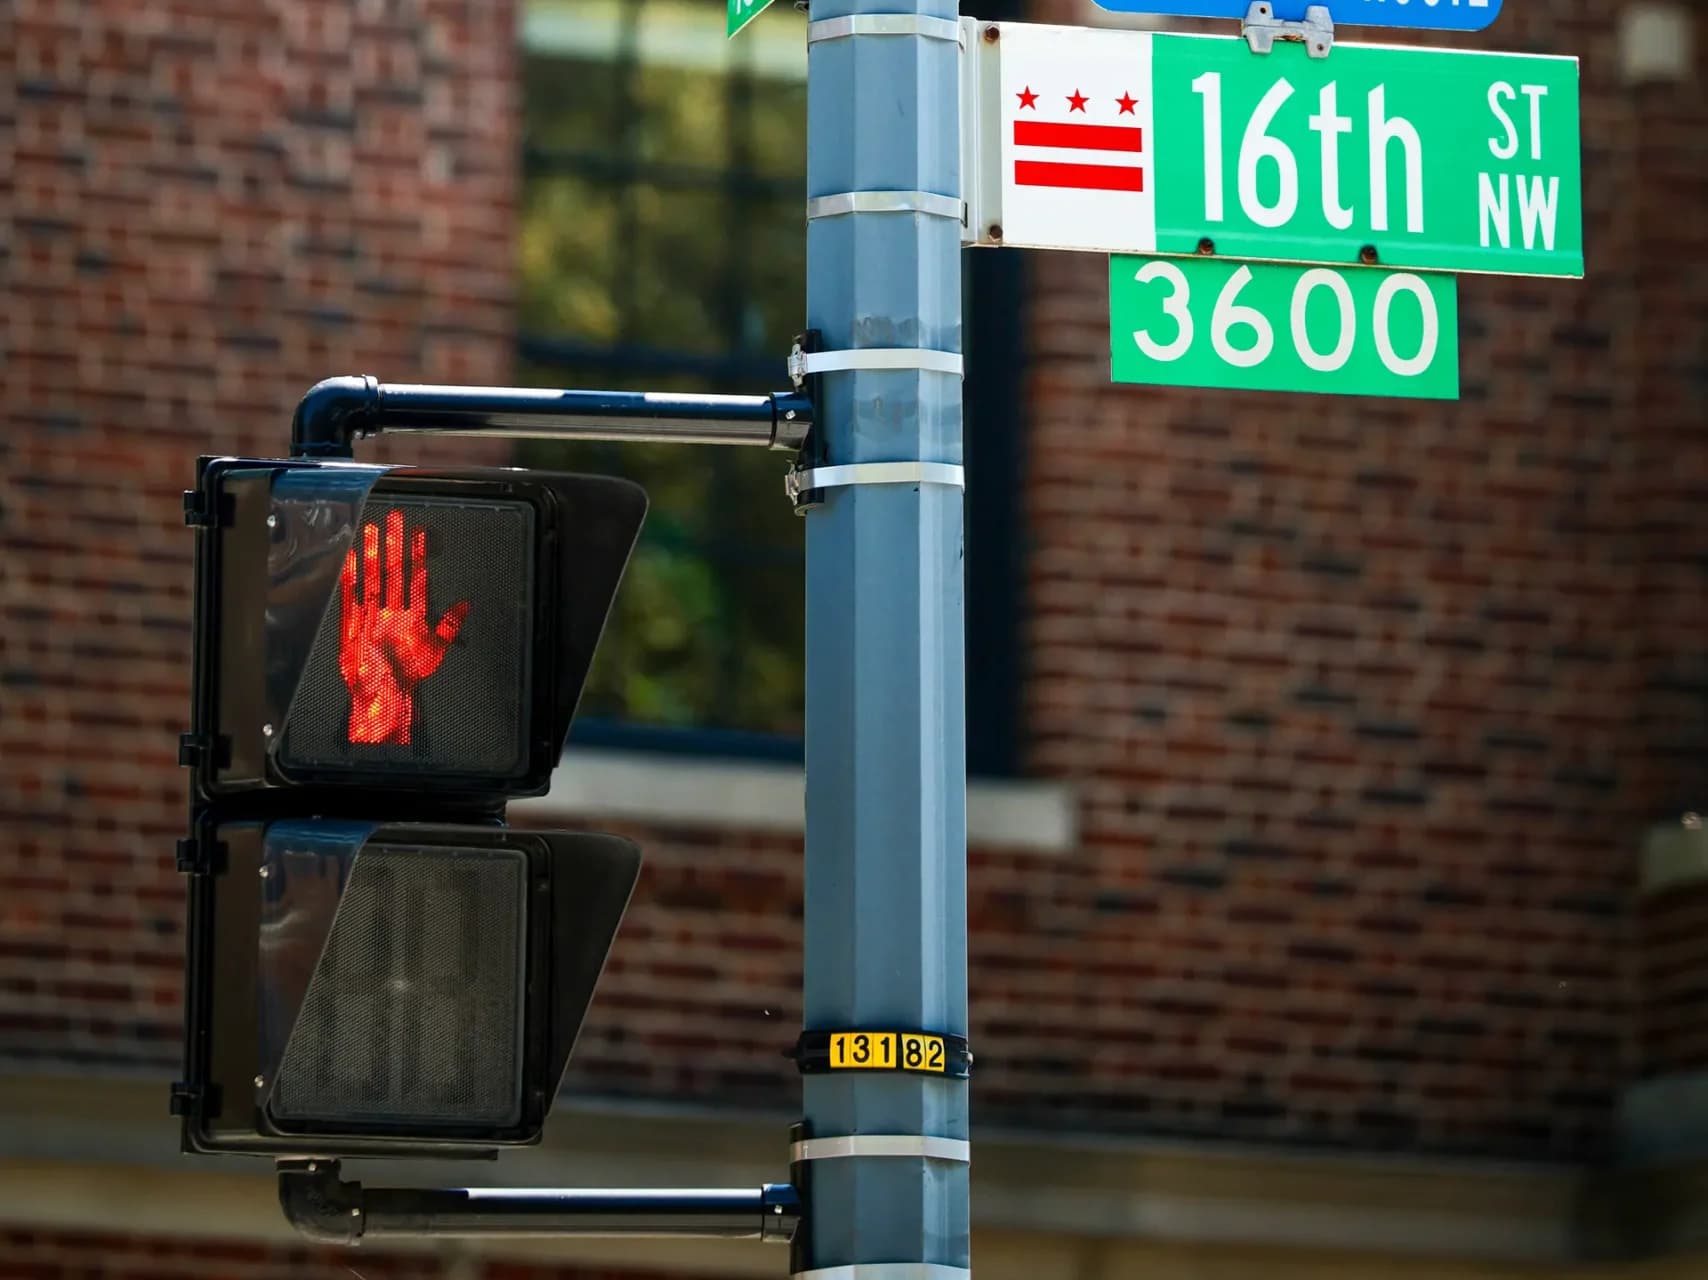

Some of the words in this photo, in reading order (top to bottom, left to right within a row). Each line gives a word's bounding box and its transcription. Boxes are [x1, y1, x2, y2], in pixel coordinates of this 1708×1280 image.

[1191, 71, 1424, 233] 16th
[1487, 81, 1548, 160] ST
[1478, 172, 1560, 251] NW
[1133, 260, 1439, 377] 3600
